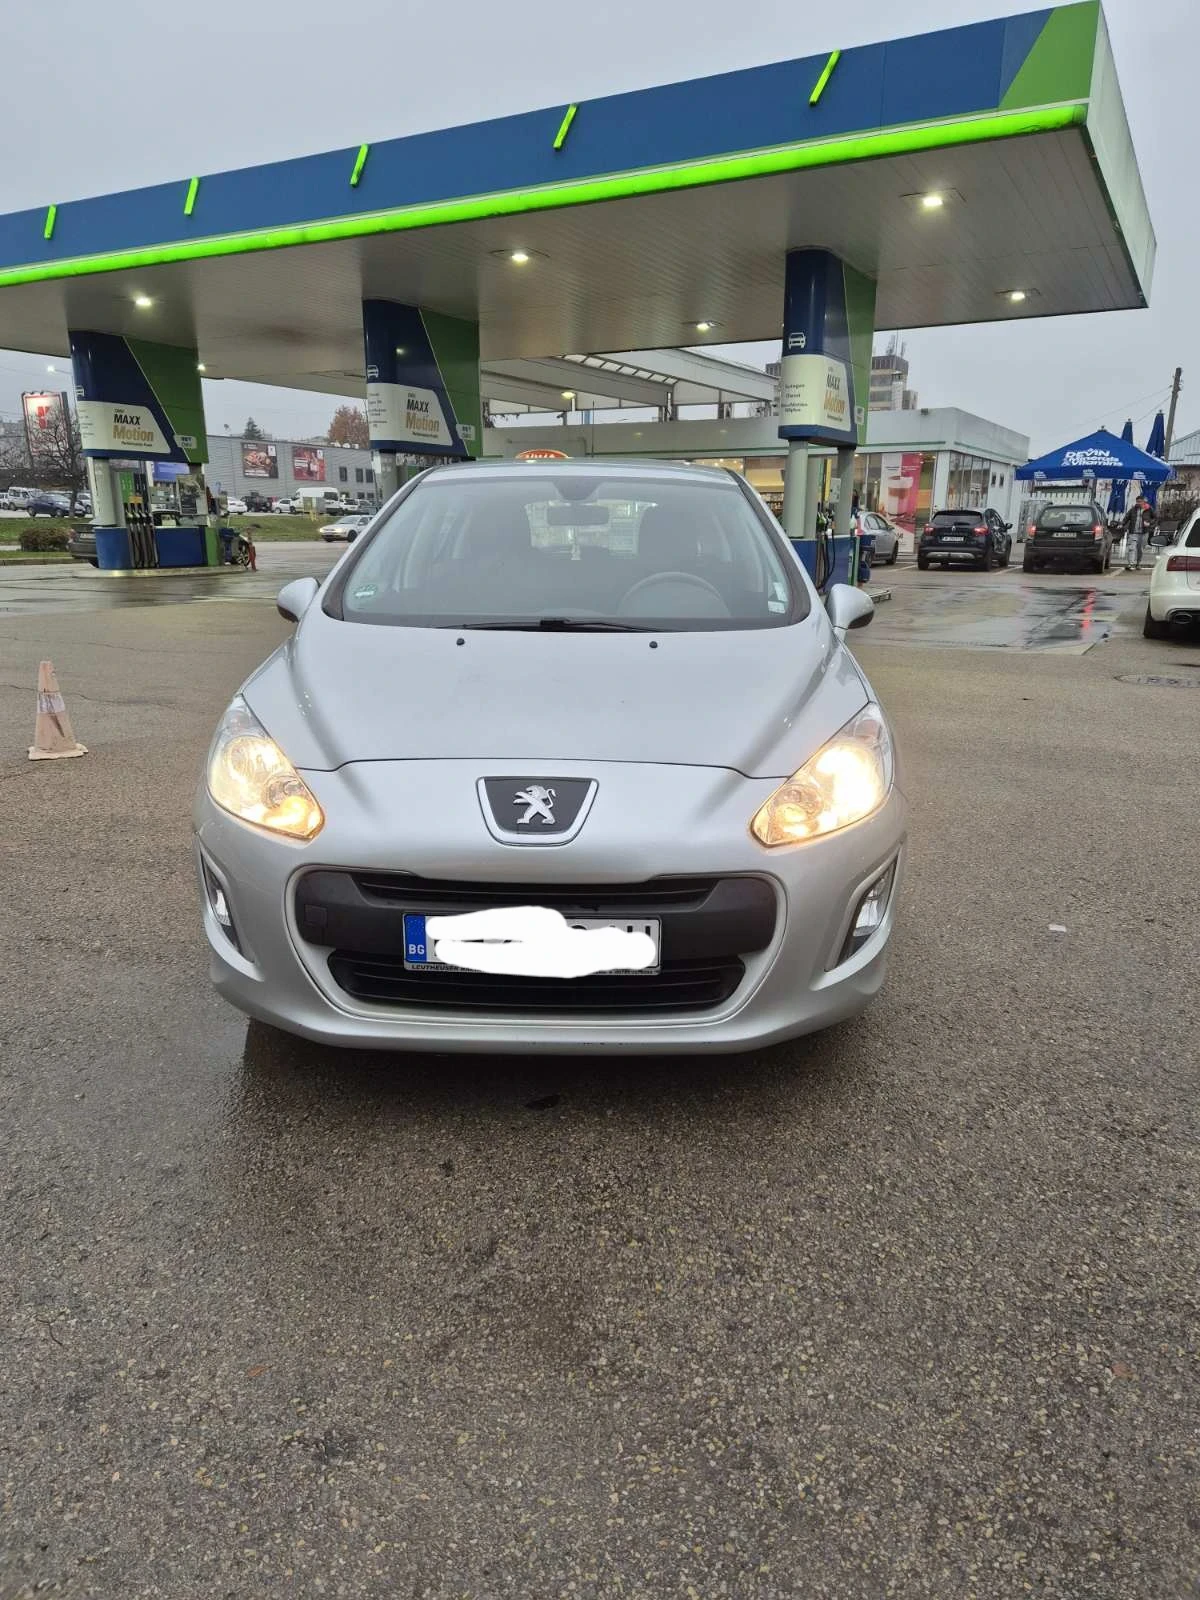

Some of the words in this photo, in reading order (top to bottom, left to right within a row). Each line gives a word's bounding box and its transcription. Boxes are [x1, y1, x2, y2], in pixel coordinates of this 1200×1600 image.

[407, 399, 429, 413] MAXX
[114, 414, 140, 425] MAXX
[406, 412, 439, 432] Motion
[113, 425, 154, 441] Motion
[1066, 449, 1110, 458] DEVIN
[408, 944, 425, 954] BG
